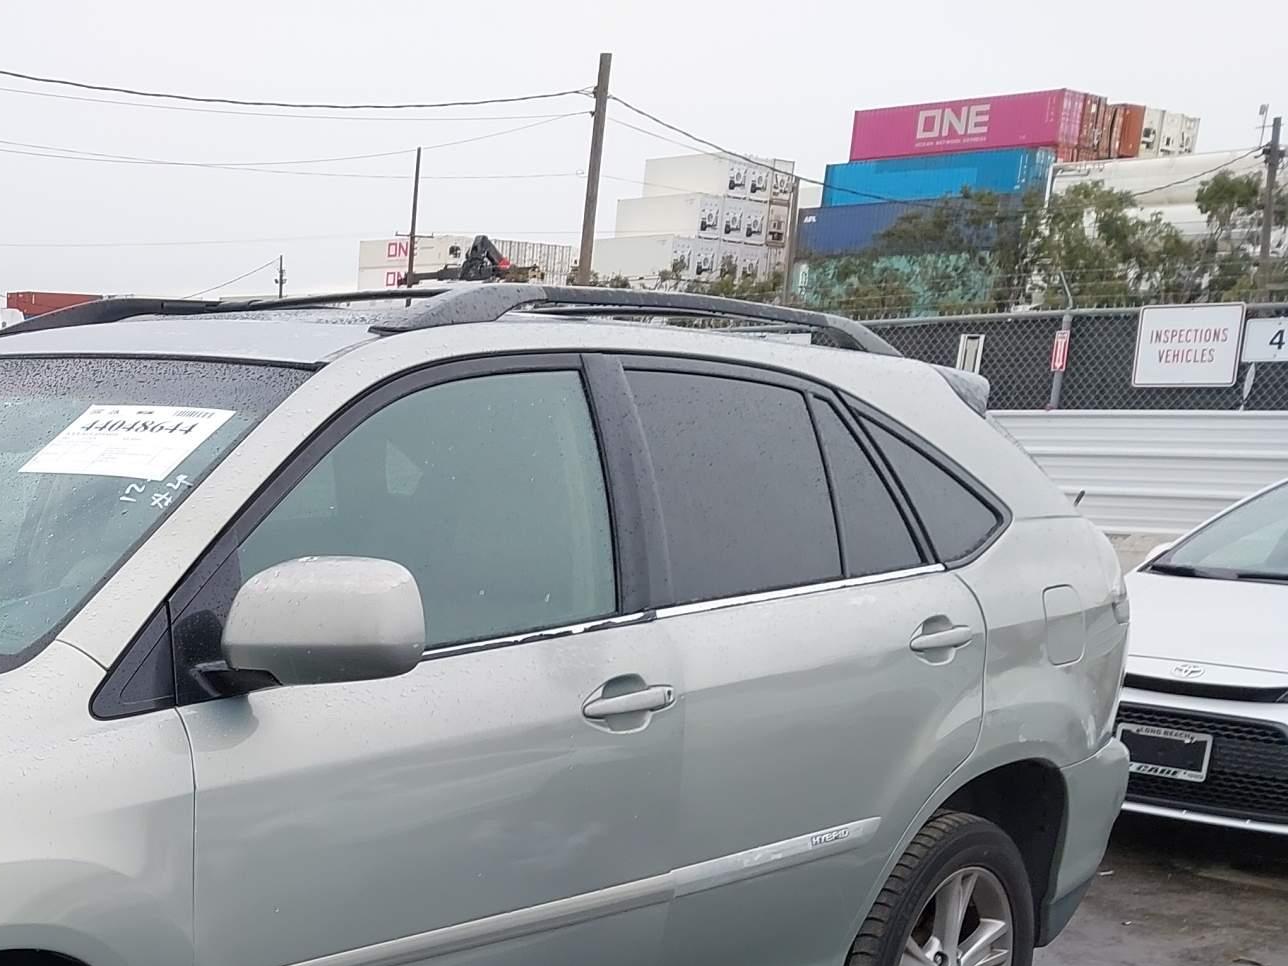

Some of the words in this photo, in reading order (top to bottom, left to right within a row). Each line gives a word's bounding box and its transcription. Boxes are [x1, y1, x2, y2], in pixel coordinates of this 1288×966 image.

[916, 103, 991, 139] ONE
[1149, 327, 1229, 344] INSPECTIONS
[1269, 329, 1286, 350] 4
[1158, 348, 1216, 364] VEHICLES
[81, 419, 201, 435] 44048644
